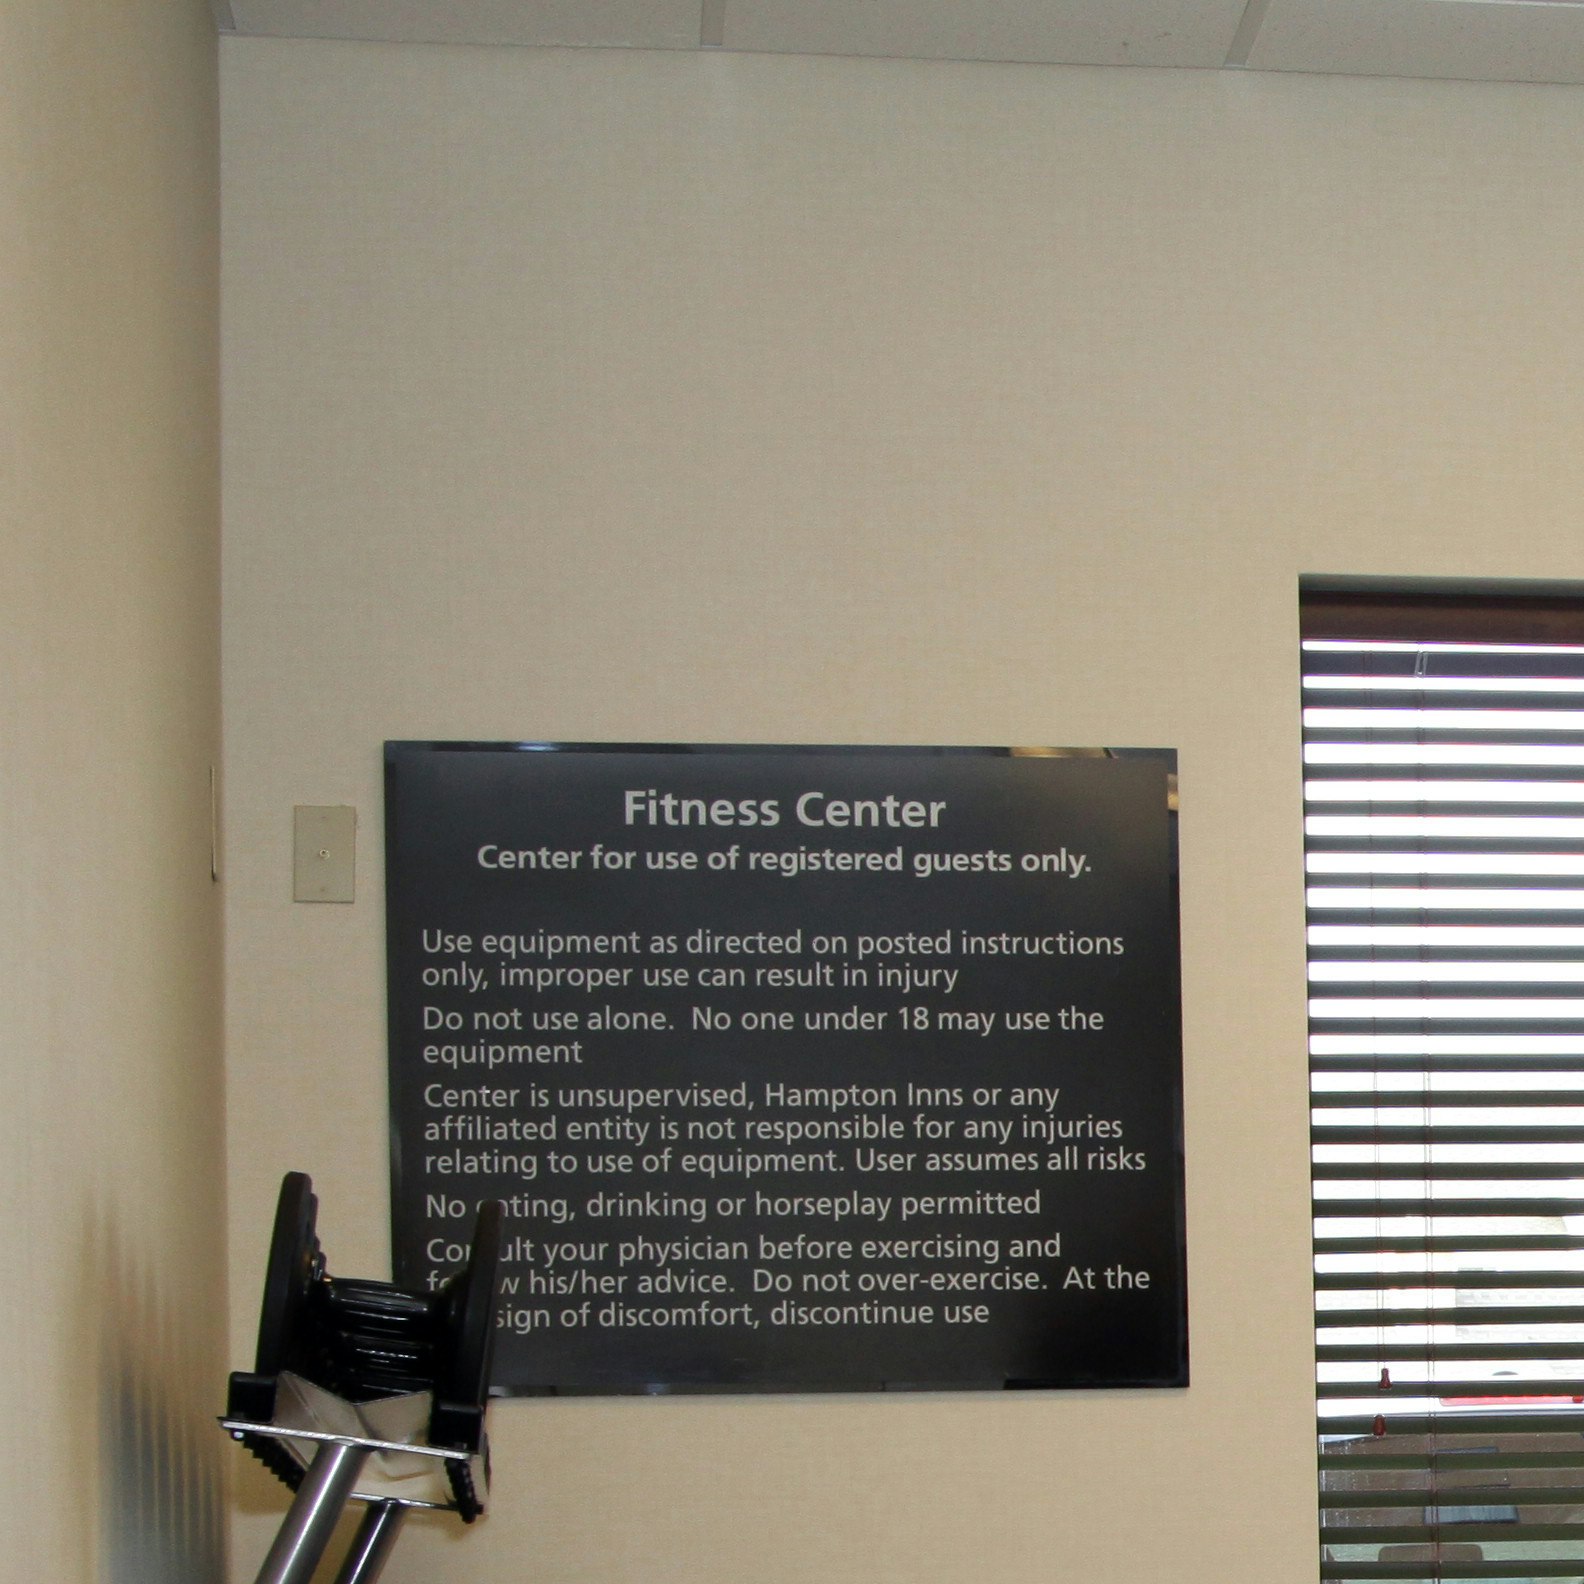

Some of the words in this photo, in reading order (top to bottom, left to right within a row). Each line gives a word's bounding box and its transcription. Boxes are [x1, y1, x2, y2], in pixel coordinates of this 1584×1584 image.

[624, 788, 780, 827] Fitness
[795, 791, 947, 828] Center
[477, 844, 583, 870] Center
[589, 843, 637, 870] for
[645, 851, 699, 870] use
[707, 844, 740, 870] of
[749, 845, 903, 877] registered
[913, 849, 1013, 878] guests
[1020, 847, 1092, 879] only.
[422, 928, 473, 954] Use
[481, 928, 641, 960] equipment
[649, 935, 678, 954] as
[685, 928, 802, 954] directed
[811, 935, 848, 954] on
[857, 928, 952, 961] posted
[961, 929, 1125, 956] instructions
[422, 960, 489, 993] only,
[500, 961, 634, 993] improper
[643, 968, 690, 987] use
[697, 968, 746, 987] can
[756, 961, 835, 987] result
[843, 962, 868, 987] in
[878, 962, 959, 994] injury
[423, 1006, 464, 1031] Do
[473, 1007, 523, 1031] not
[532, 1011, 579, 1031] use
[586, 1004, 674, 1031] alone.
[692, 1006, 732, 1031] No
[740, 1011, 795, 1031] one
[804, 1005, 888, 1031] under
[898, 1006, 930, 1031] 18
[937, 1012, 996, 1037] may
[1005, 1012, 1051, 1031] use
[1057, 1005, 1105, 1031] the
[423, 1038, 583, 1070] equipment
[423, 1083, 521, 1108] Center
[530, 1082, 550, 1108] is
[558, 1081, 754, 1114] unsupervised,
[765, 1082, 897, 1113] Hampton
[907, 1082, 964, 1107] Inns
[972, 1087, 1003, 1107] or
[1010, 1087, 1060, 1113] any
[424, 1114, 557, 1141] affiliated
[566, 1115, 650, 1147] entity
[660, 1115, 679, 1140] is
[688, 1117, 736, 1140] not
[745, 1113, 905, 1146] responsible
[912, 1113, 956, 1139] for
[963, 1120, 1014, 1145] any
[1022, 1113, 1123, 1145] injuries
[425, 1148, 538, 1180] relating
[546, 1150, 578, 1174] to
[587, 1154, 634, 1174] use
[641, 1146, 673, 1173] of
[681, 1147, 845, 1179] equipment.
[855, 1147, 917, 1172] User
[925, 1152, 1039, 1172] assumes
[1046, 1145, 1078, 1171] all
[1087, 1145, 1147, 1171] risks
[426, 1194, 467, 1219] No
[586, 1191, 707, 1223] drinking
[716, 1197, 747, 1217] or
[755, 1190, 892, 1222] horseplay
[901, 1188, 1041, 1222] permitted
[426, 1236, 535, 1263] Coult
[543, 1242, 609, 1268] your
[618, 1235, 749, 1268] physician
[759, 1233, 853, 1260] before
[861, 1233, 1000, 1265] exercising
[1008, 1232, 1061, 1258] and
[529, 1268, 629, 1295] his/her
[637, 1268, 735, 1294] advice.
[753, 1268, 793, 1293] Do
[802, 1269, 851, 1292] not
[857, 1265, 1048, 1292] over-exercise.
[1062, 1265, 1096, 1290] At
[1103, 1263, 1151, 1290] the
[496, 1303, 551, 1335] sign
[560, 1301, 591, 1328] of
[598, 1300, 760, 1330] discomfort,
[770, 1299, 934, 1326] discontinue
[944, 1304, 990, 1324] use
